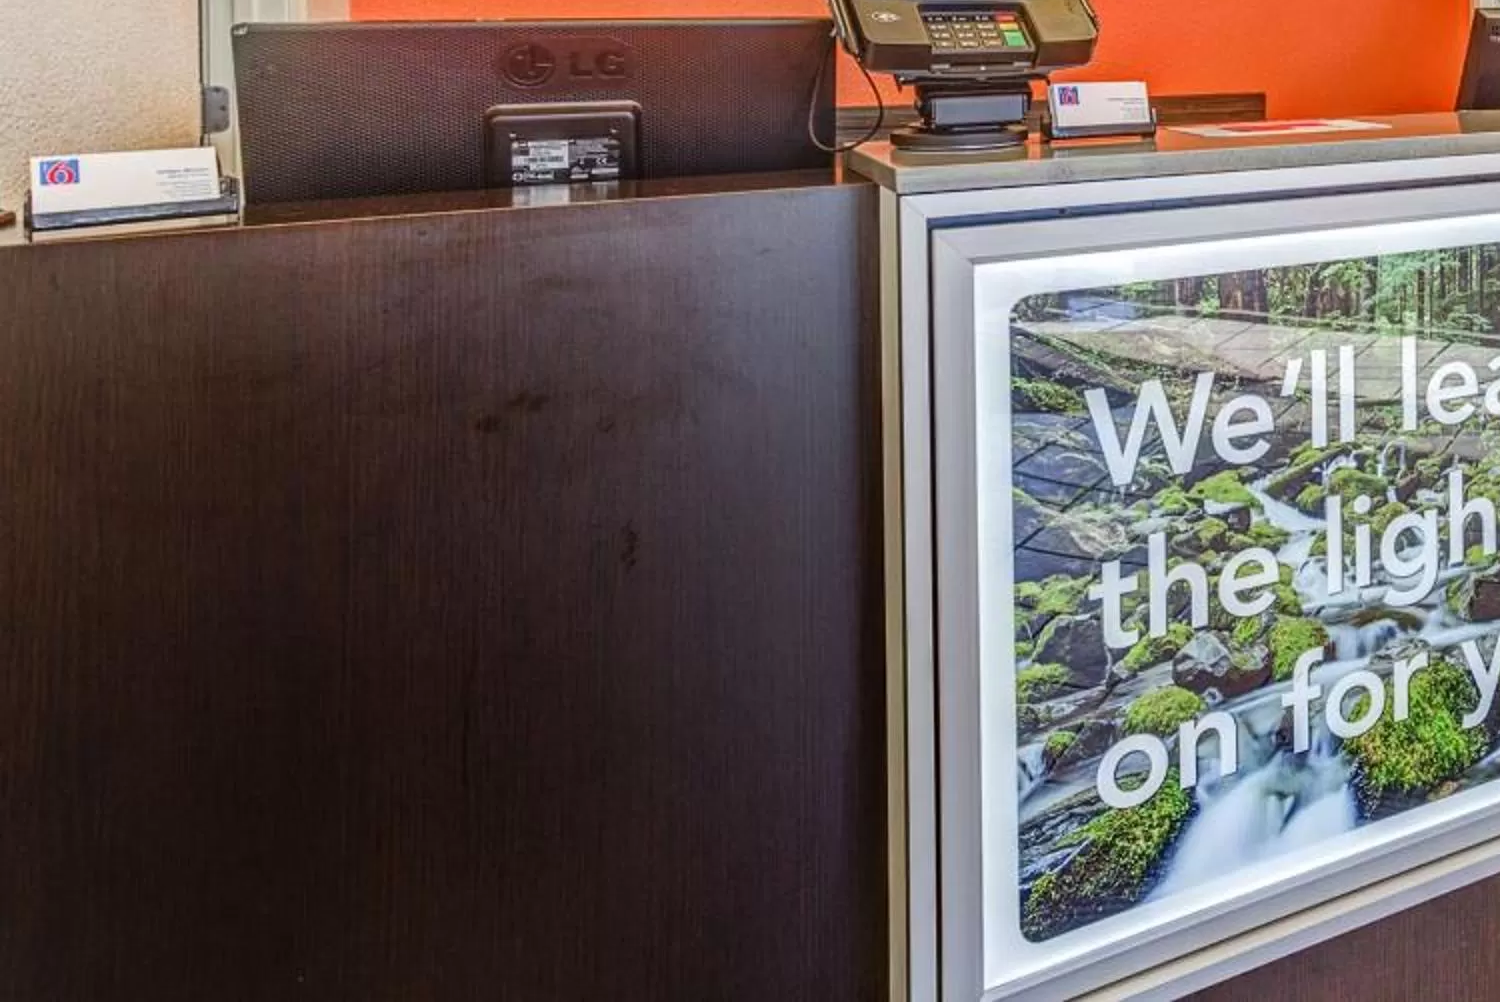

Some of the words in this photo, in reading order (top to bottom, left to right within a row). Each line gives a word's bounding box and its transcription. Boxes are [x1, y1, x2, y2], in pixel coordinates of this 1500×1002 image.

[569, 51, 626, 79] LG
[1084, 345, 1356, 486] We'll
[1088, 532, 1280, 648] the
[1096, 711, 1238, 809] on
[1281, 646, 1429, 754] for
